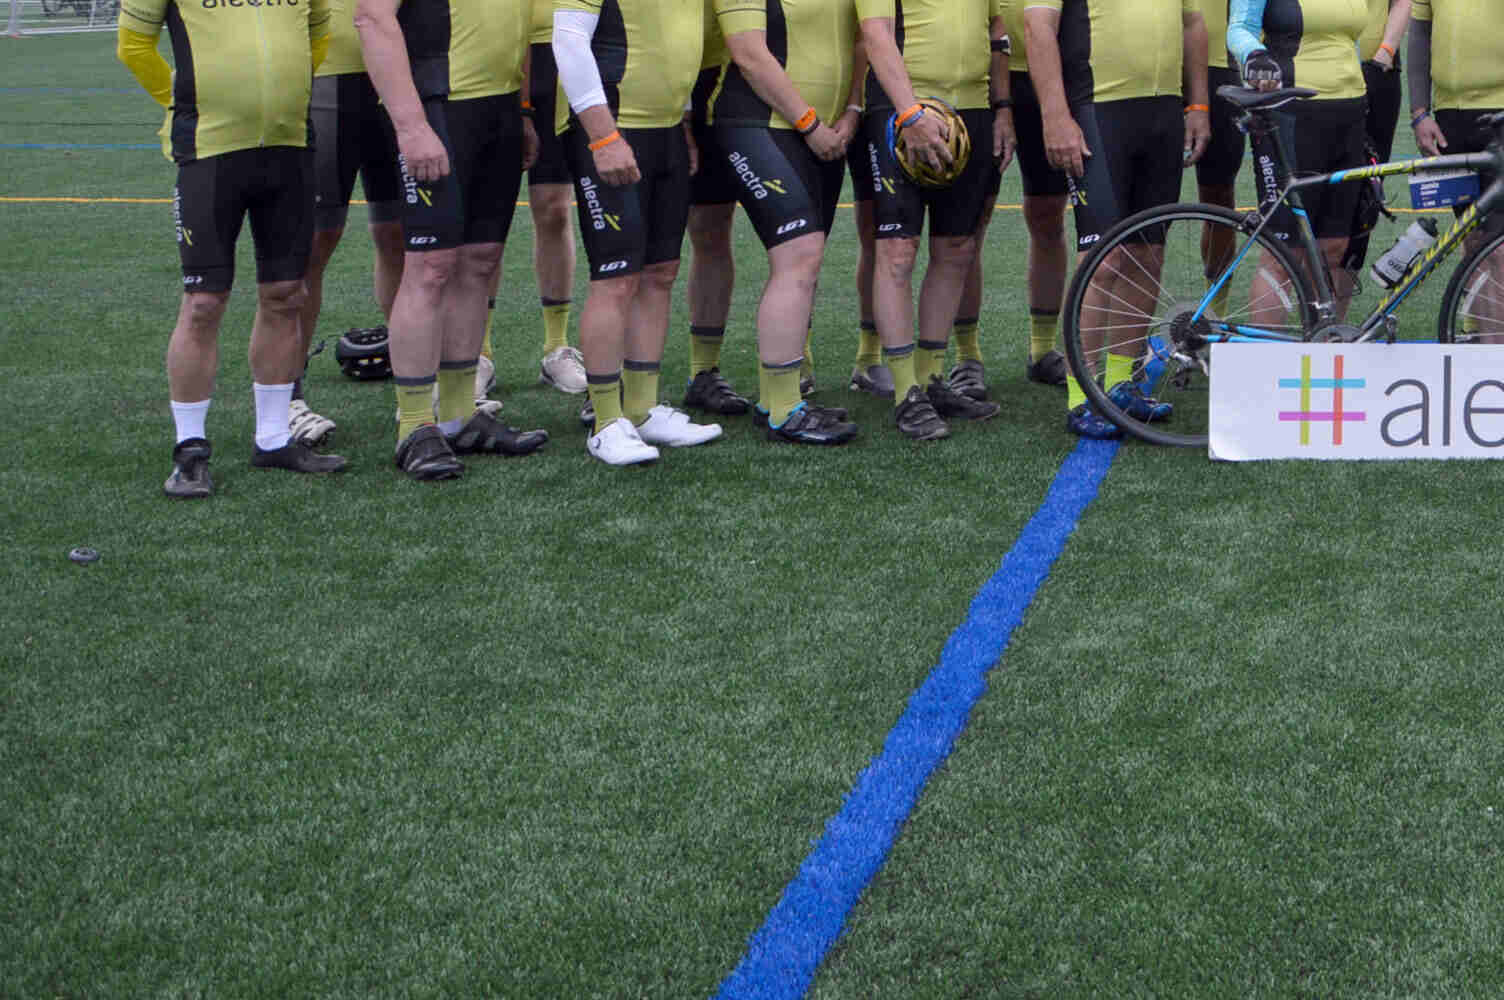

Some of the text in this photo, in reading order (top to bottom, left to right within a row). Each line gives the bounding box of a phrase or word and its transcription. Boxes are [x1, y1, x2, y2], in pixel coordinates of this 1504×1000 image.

[728, 151, 768, 200] alectra
[1258, 154, 1278, 203] alectra
[579, 175, 606, 231] alectra
